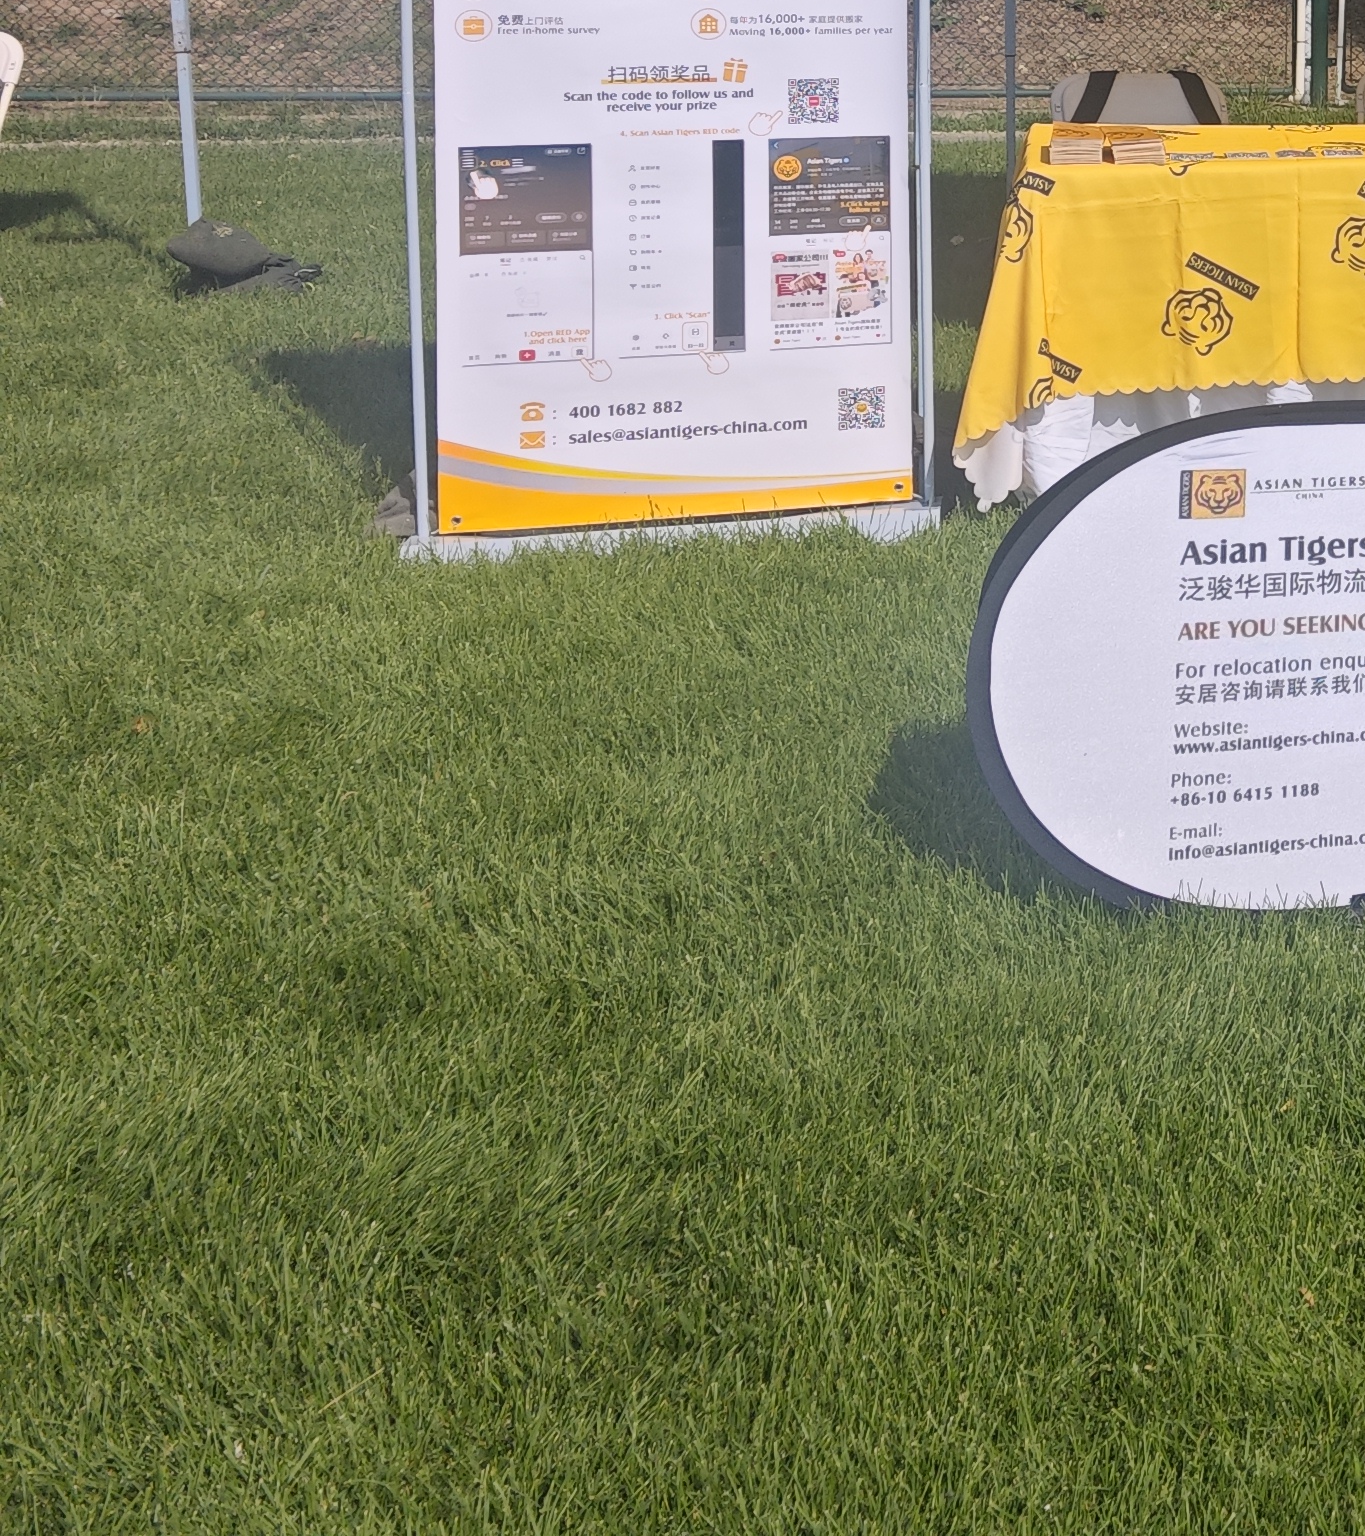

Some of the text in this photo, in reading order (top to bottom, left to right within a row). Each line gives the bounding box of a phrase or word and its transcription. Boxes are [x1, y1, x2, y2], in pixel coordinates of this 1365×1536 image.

[567, 27, 600, 36] survey
[729, 28, 765, 37] Moving
[607, 64, 711, 82] 扫码领奖品
[564, 88, 754, 102] Scan the code to follow us and
[607, 101, 717, 112] receive your prize
[1188, 254, 1258, 297] ASIAN TIGERS
[568, 400, 683, 419] 400 1682 882
[568, 419, 808, 445] sales@asiantigers-china.com
[1253, 477, 1303, 491] ASIAN
[1296, 492, 1324, 500] CHINA
[1180, 538, 1267, 566] Asian
[1178, 621, 1221, 641] ARE
[1227, 618, 1276, 639] YOU
[1175, 663, 1206, 679] For
[1213, 657, 1312, 676] relocation
[1173, 721, 1249, 738] Website:
[1170, 772, 1232, 788] Phone:
[1170, 782, 1320, 806] +86-10 6415 1188
[1169, 823, 1223, 840] E-mail:
